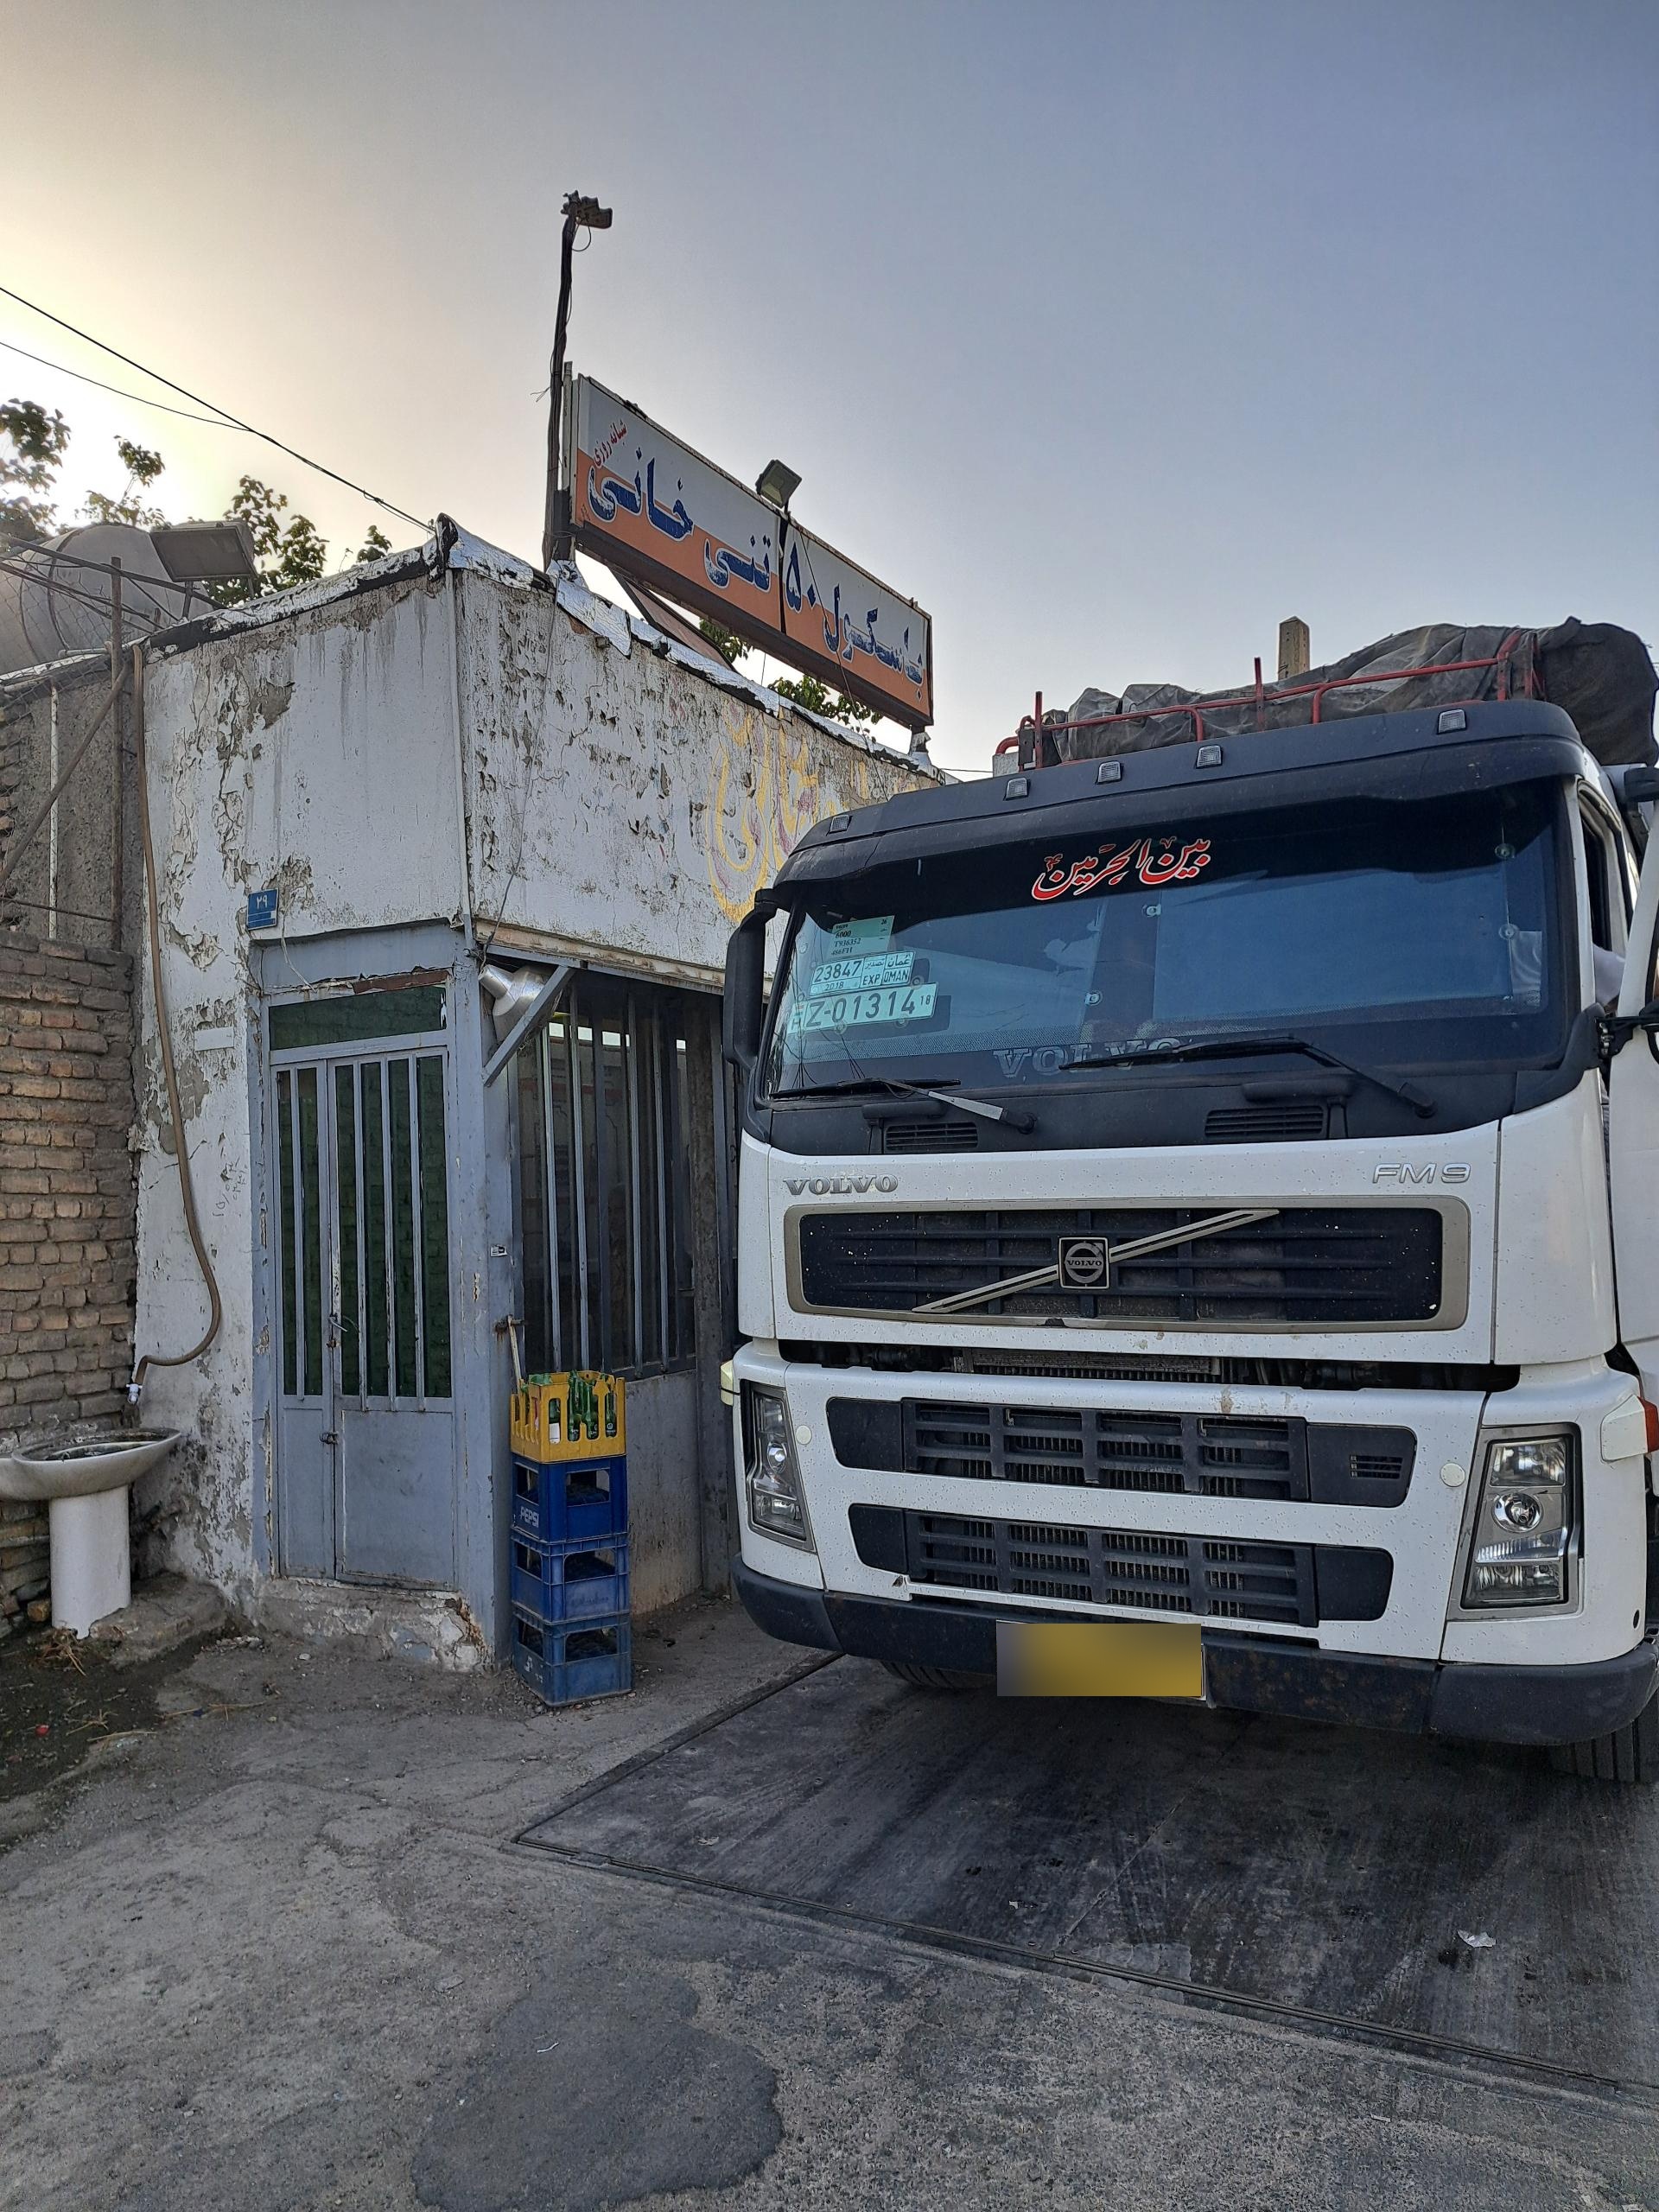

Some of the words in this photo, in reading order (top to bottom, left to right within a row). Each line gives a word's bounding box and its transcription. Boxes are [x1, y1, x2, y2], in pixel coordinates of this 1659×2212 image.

[588, 447, 694, 541] خانی
[703, 534, 772, 593] تنی
[823, 582, 923, 702] باسکول
[814, 960, 861, 982] 23847
[862, 974, 880, 985] EXP
[883, 969, 909, 982] OMAN
[825, 981, 844, 990] 2018
[805, 989, 915, 1027] Z-01314
[920, 995, 931, 1006] 18
[782, 1174, 899, 1196] VOLVO
[520, 1506, 540, 1529] PEPSI
